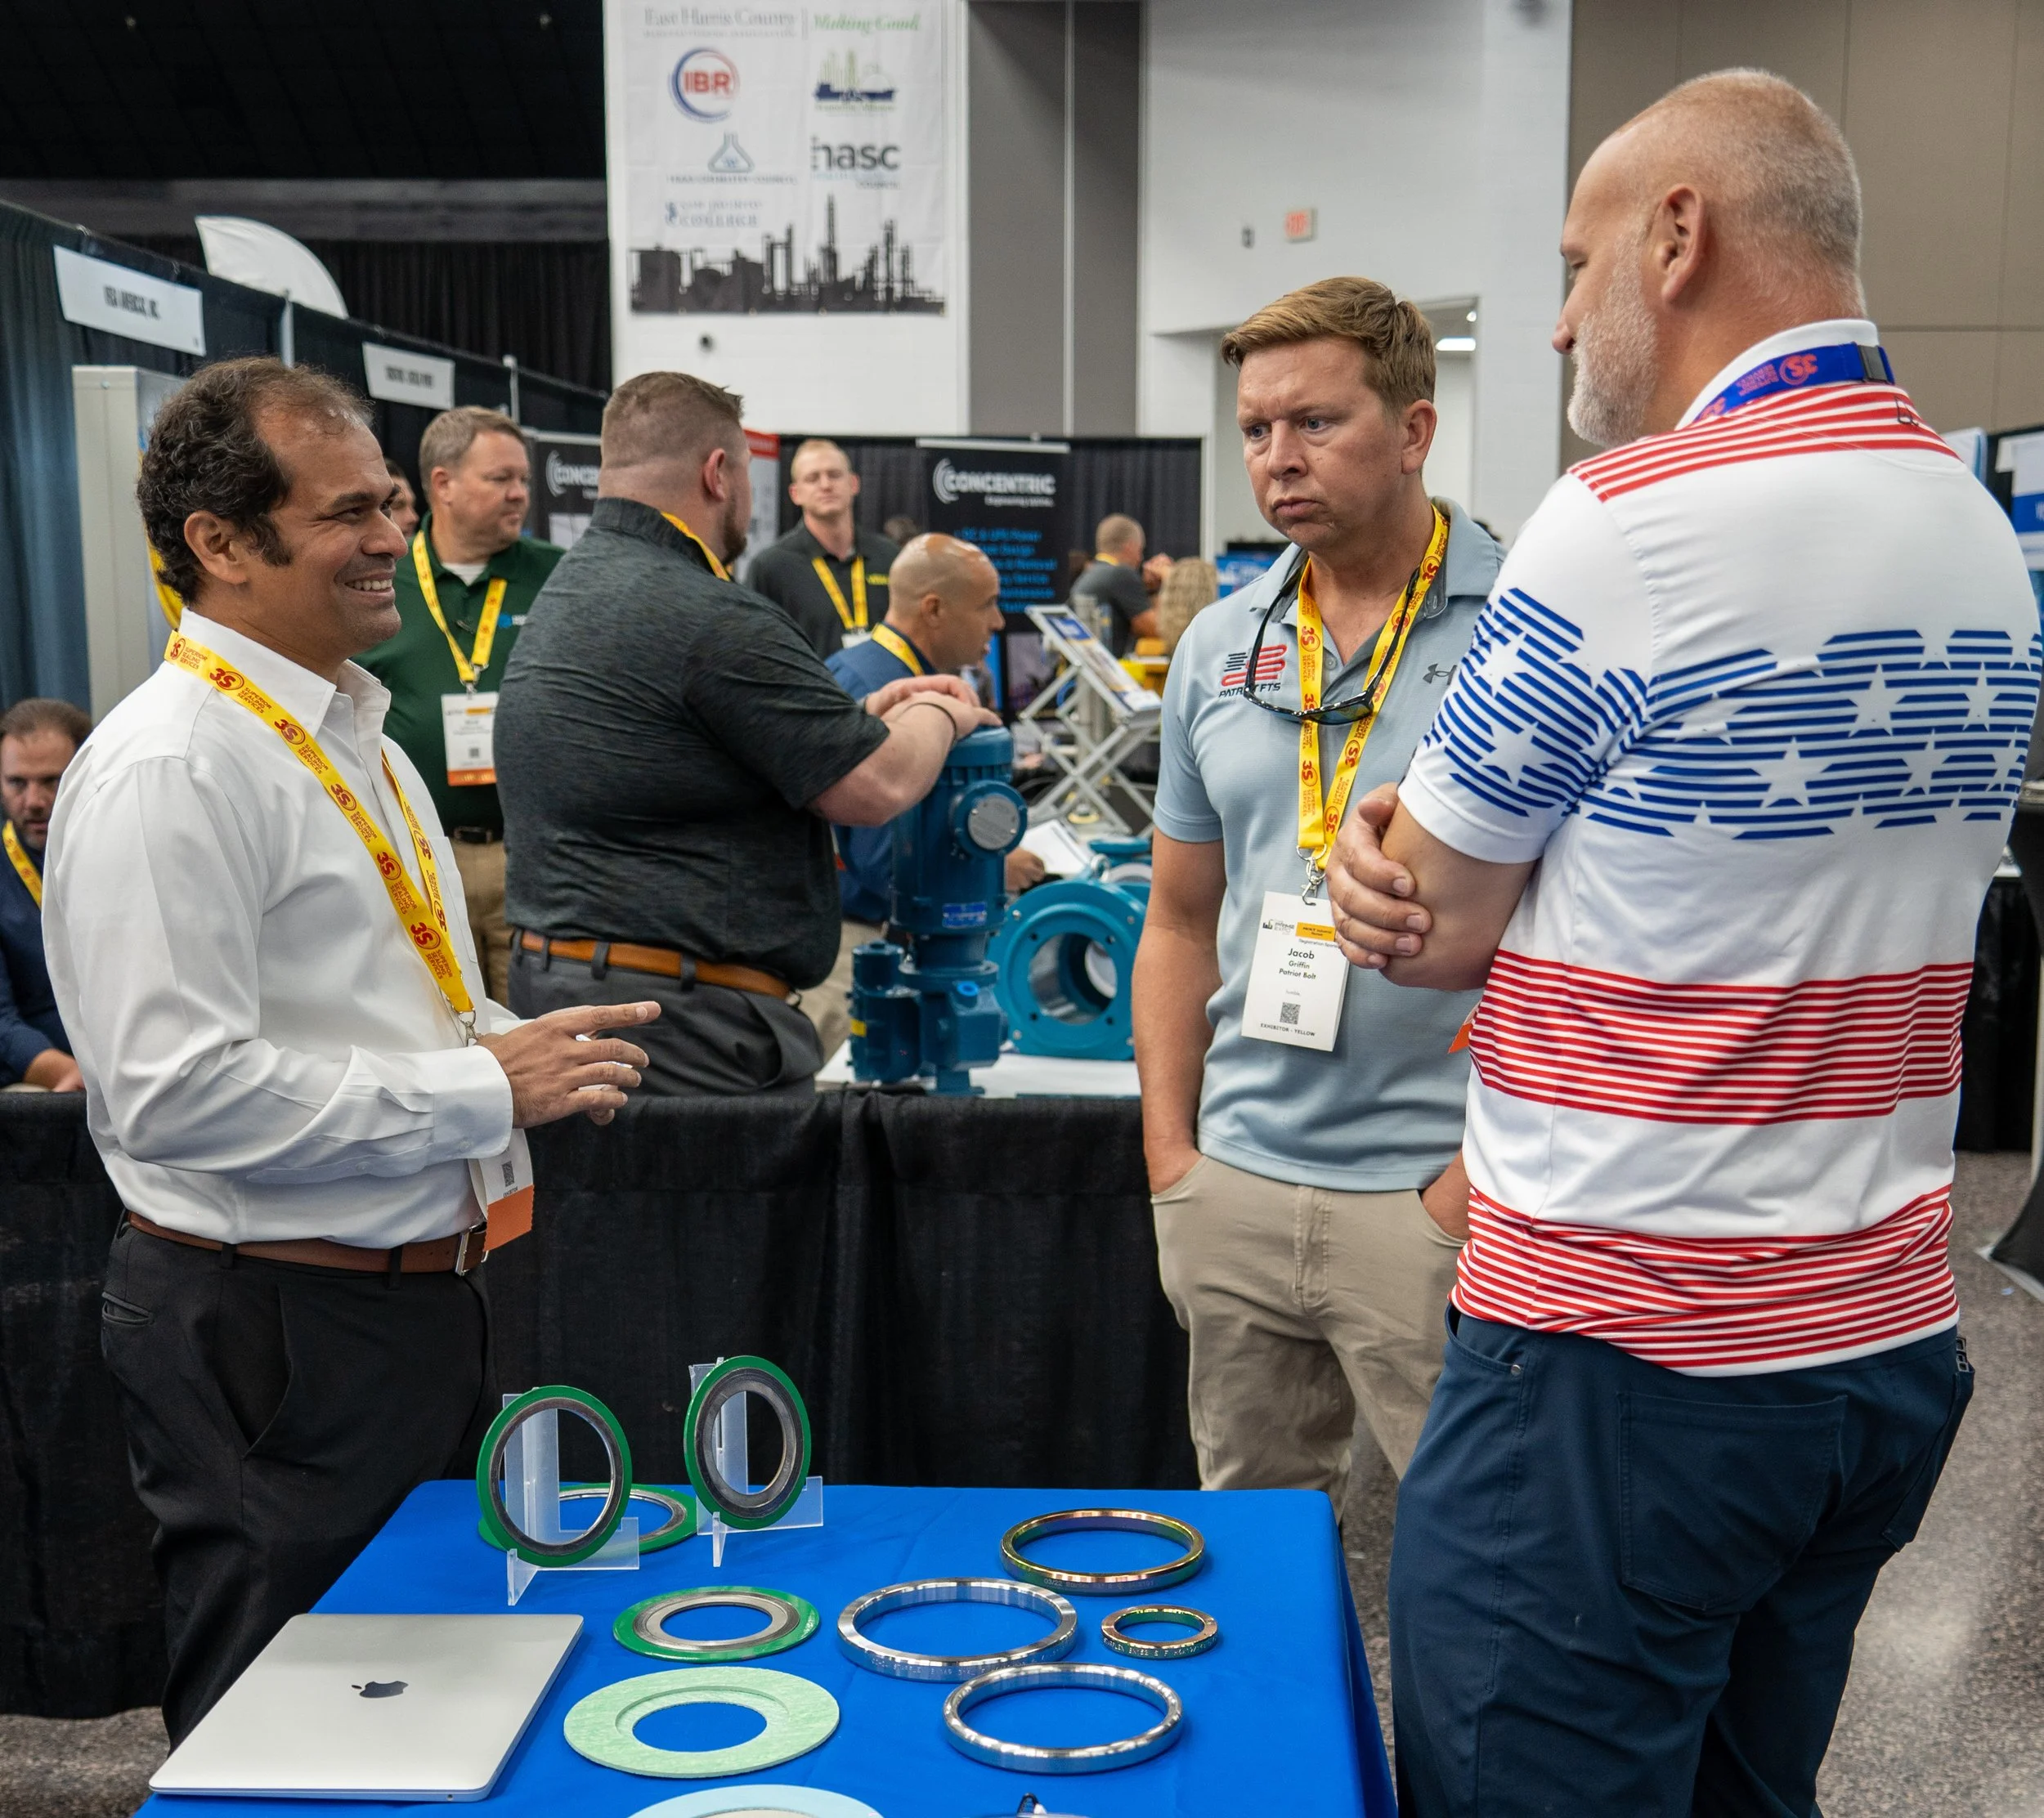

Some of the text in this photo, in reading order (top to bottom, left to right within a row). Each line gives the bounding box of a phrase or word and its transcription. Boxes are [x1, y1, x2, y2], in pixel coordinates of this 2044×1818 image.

[944, 470, 1056, 495] CONCENTRIC
[185, 647, 208, 661] SUPERIOR
[209, 668, 236, 687] 3S
[237, 692, 264, 714] SERVICES
[241, 690, 266, 709] SEALING
[244, 687, 272, 710] SUPERIOR
[274, 719, 298, 741] 3S
[298, 749, 322, 774] SERVICES
[301, 746, 322, 769] SEALING
[304, 744, 329, 771] SUPERIOR
[1302, 759, 1314, 781] 3S
[330, 783, 351, 806] 3S
[350, 815, 371, 844] SERVICES
[353, 813, 372, 838] SEALING
[356, 811, 378, 839] SUPERIOR
[377, 851, 395, 875] 3S
[390, 885, 408, 915] SERVICES
[394, 882, 410, 909] SEALING
[399, 880, 418, 909] SUPERIOR
[410, 922, 434, 945] 3S
[431, 952, 446, 975] SEALING
[437, 949, 453, 978] SUPERIOR
[1288, 948, 1315, 960] Jacob
[1289, 960, 1310, 969] Griffin
[426, 954, 443, 979] SERVICES
[1279, 968, 1302, 978] Patriot
[1260, 1023, 1289, 1032] EXHIBITOR
[1294, 1028, 1316, 1037] YELLOW
